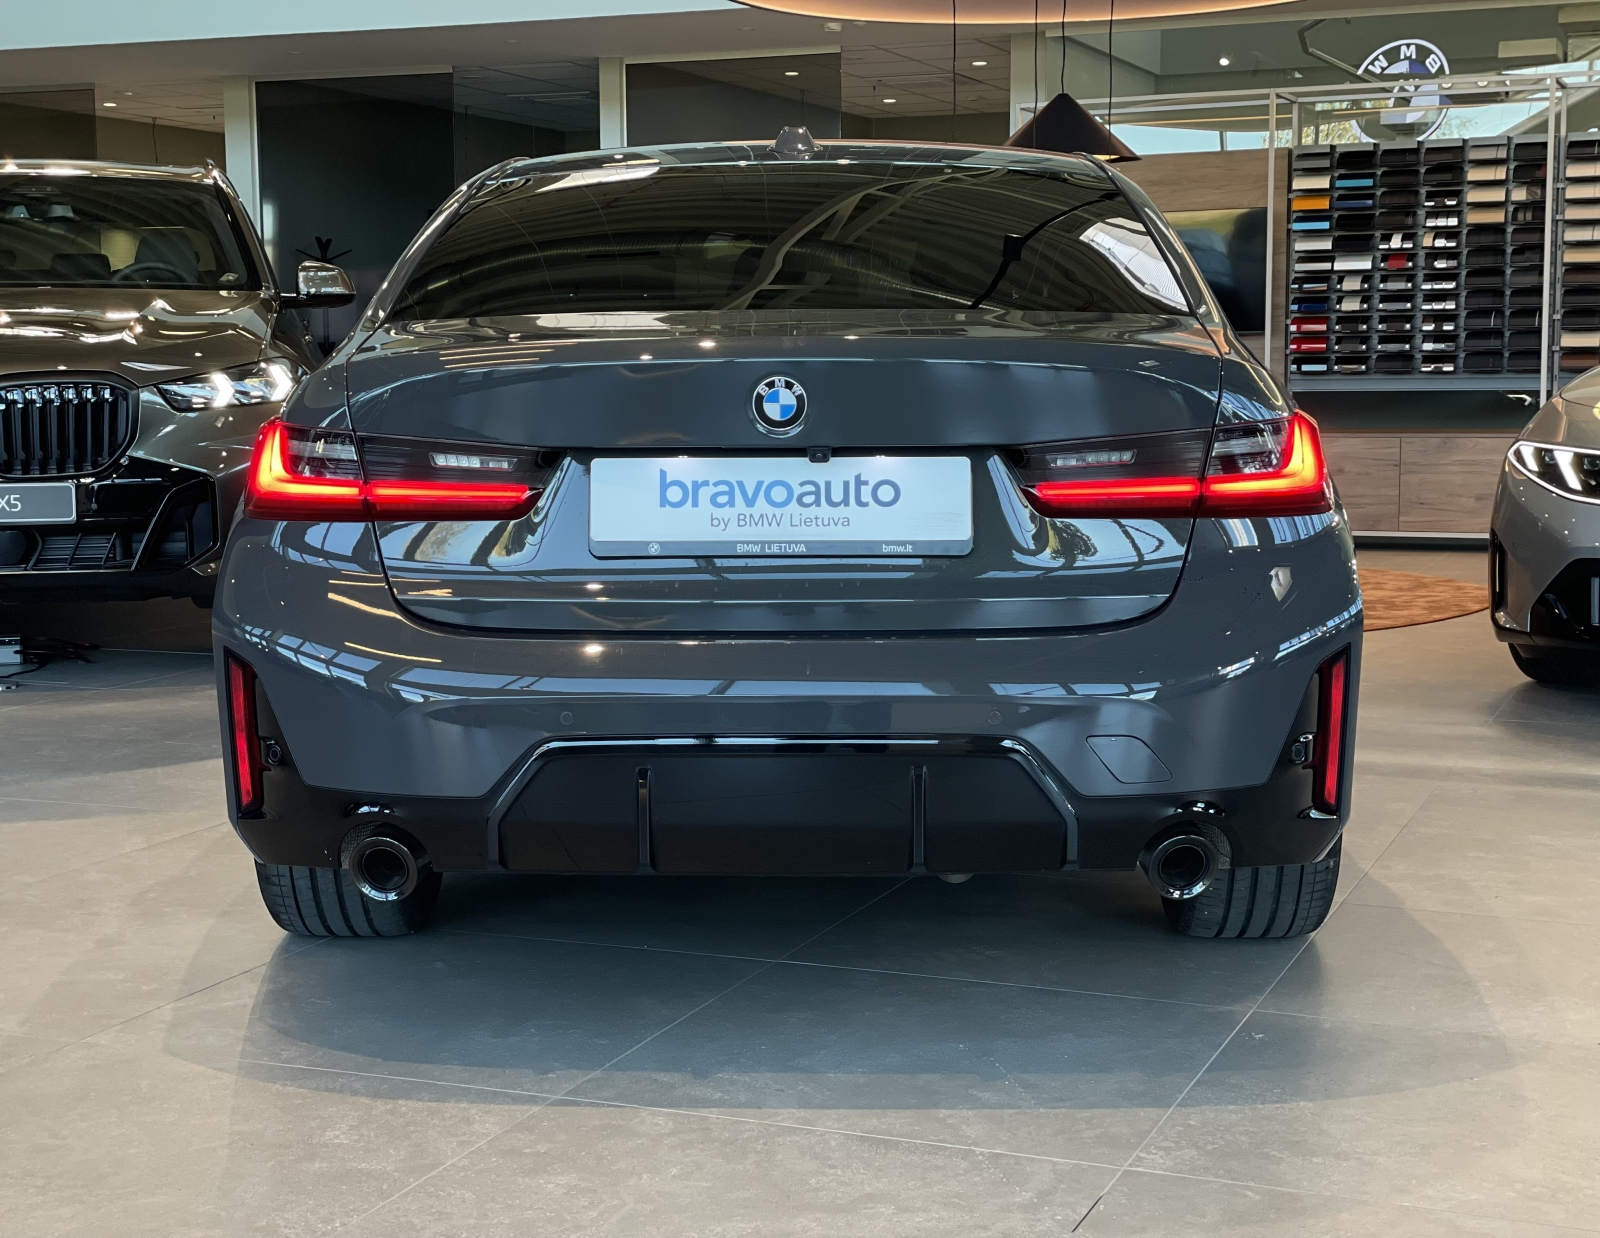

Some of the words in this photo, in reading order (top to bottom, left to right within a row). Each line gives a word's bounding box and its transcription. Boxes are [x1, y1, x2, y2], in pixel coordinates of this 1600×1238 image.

[758, 378, 803, 396] BMW
[659, 468, 902, 508] bravoauto
[0, 494, 22, 512] X5
[710, 512, 731, 531] by
[737, 513, 784, 527] BMW
[790, 513, 850, 527] Lietuva
[736, 543, 761, 553] BMW
[765, 543, 807, 553] LIETUVA
[882, 543, 913, 553] bmw.lt
